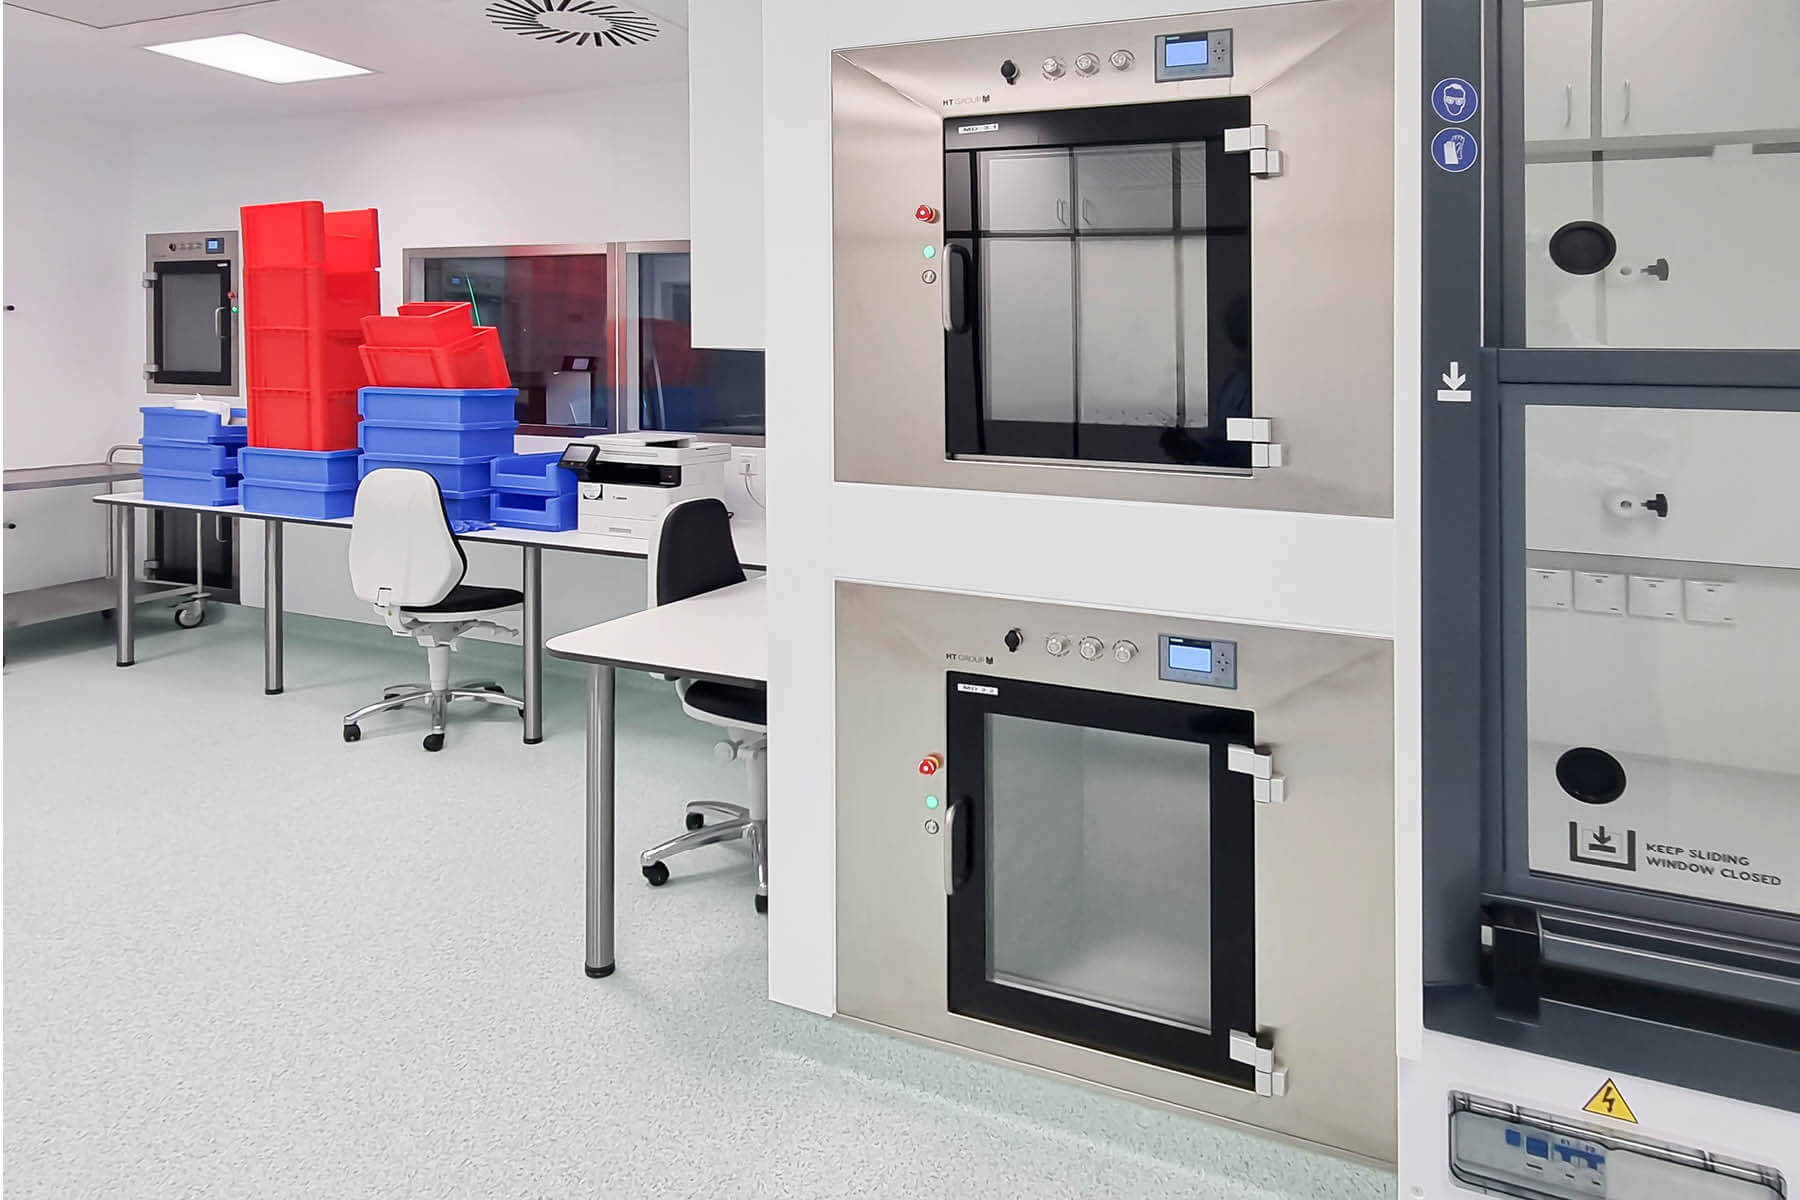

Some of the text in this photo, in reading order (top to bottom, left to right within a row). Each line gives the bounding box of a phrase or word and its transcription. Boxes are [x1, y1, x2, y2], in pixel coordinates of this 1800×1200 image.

[1646, 843, 1750, 866] KEEP SLIDING
[1646, 856, 1781, 886] WINDOW CLOSED
